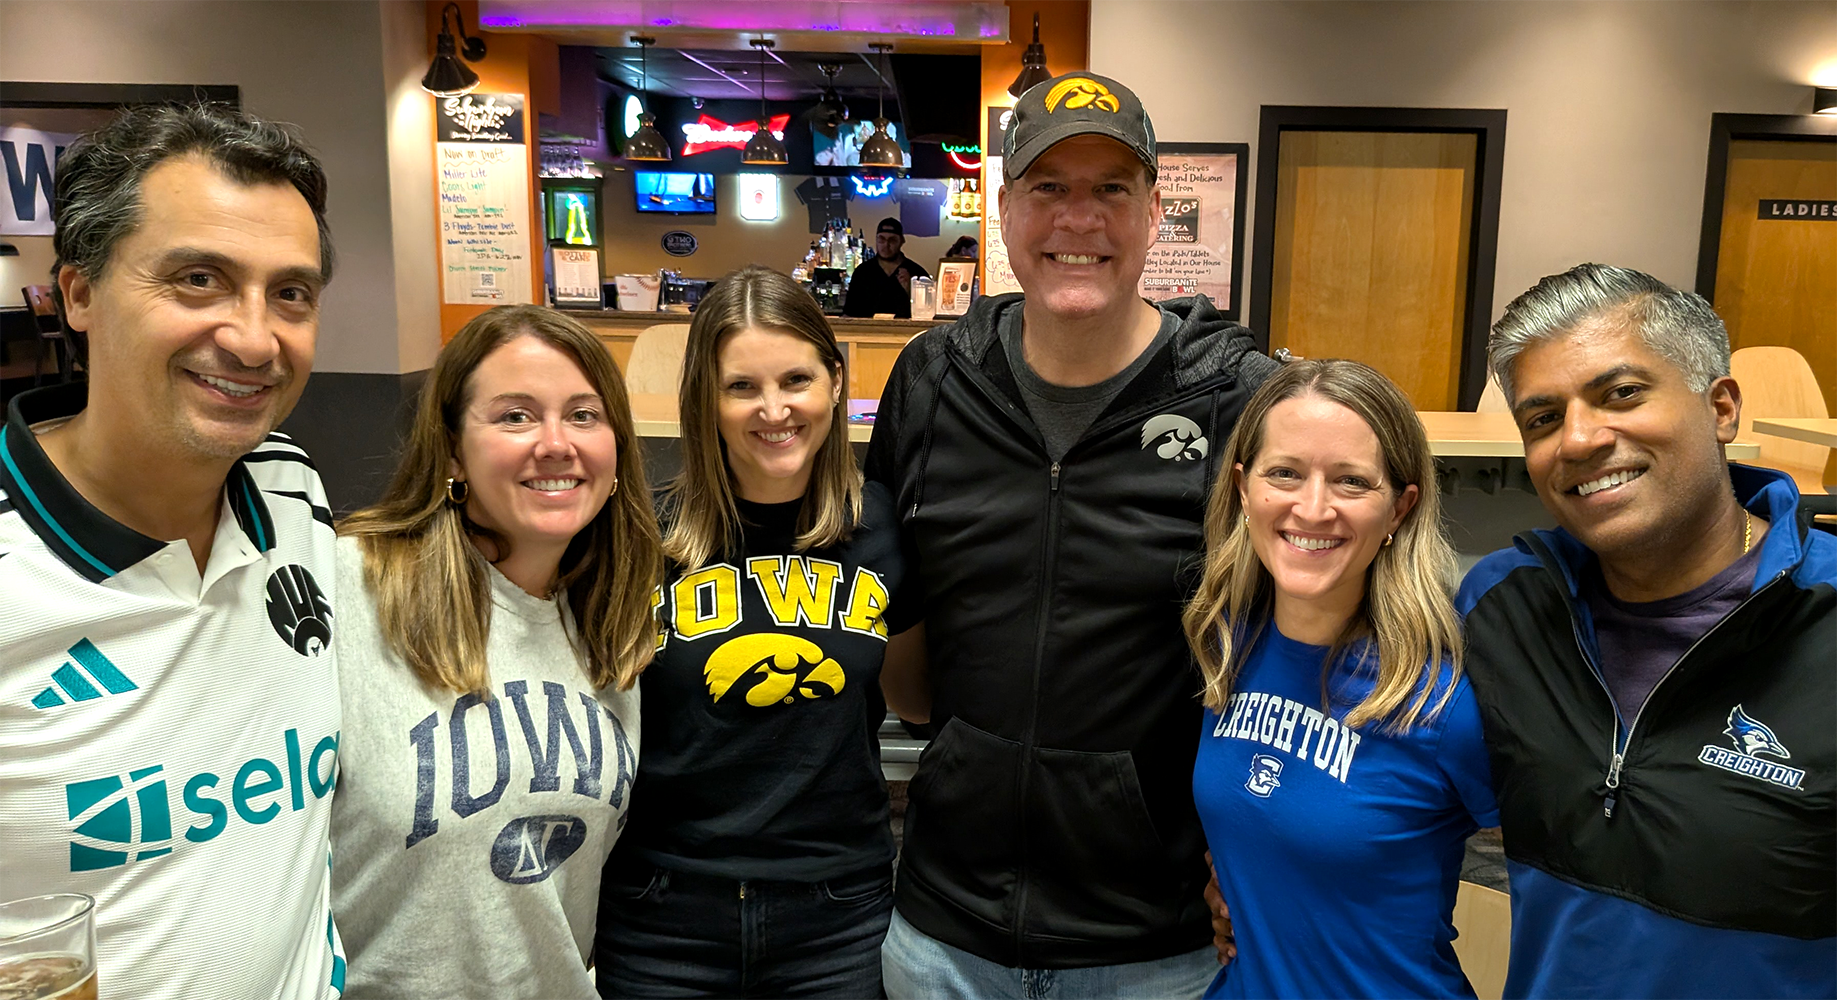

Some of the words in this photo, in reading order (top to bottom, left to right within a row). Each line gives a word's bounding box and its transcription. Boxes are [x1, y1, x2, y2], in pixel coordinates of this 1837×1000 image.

[467, 149, 477, 158] on
[480, 147, 506, 160] Draft
[1182, 162, 1210, 172] Serves
[443, 168, 466, 179] Miller
[470, 167, 487, 178] Lite
[1174, 173, 1188, 183] and
[1189, 173, 1223, 183] Delicious
[441, 181, 466, 193] Coors
[1175, 183, 1194, 192] from
[1158, 224, 1189, 232] PIZZA
[1189, 258, 1201, 267] Our
[1202, 258, 1222, 266] House
[1172, 286, 1196, 294] BOWL
[1213, 692, 1362, 784] CREIGHTON
[405, 679, 637, 850] IOWA
[1702, 747, 1800, 787] CREIGHTON
